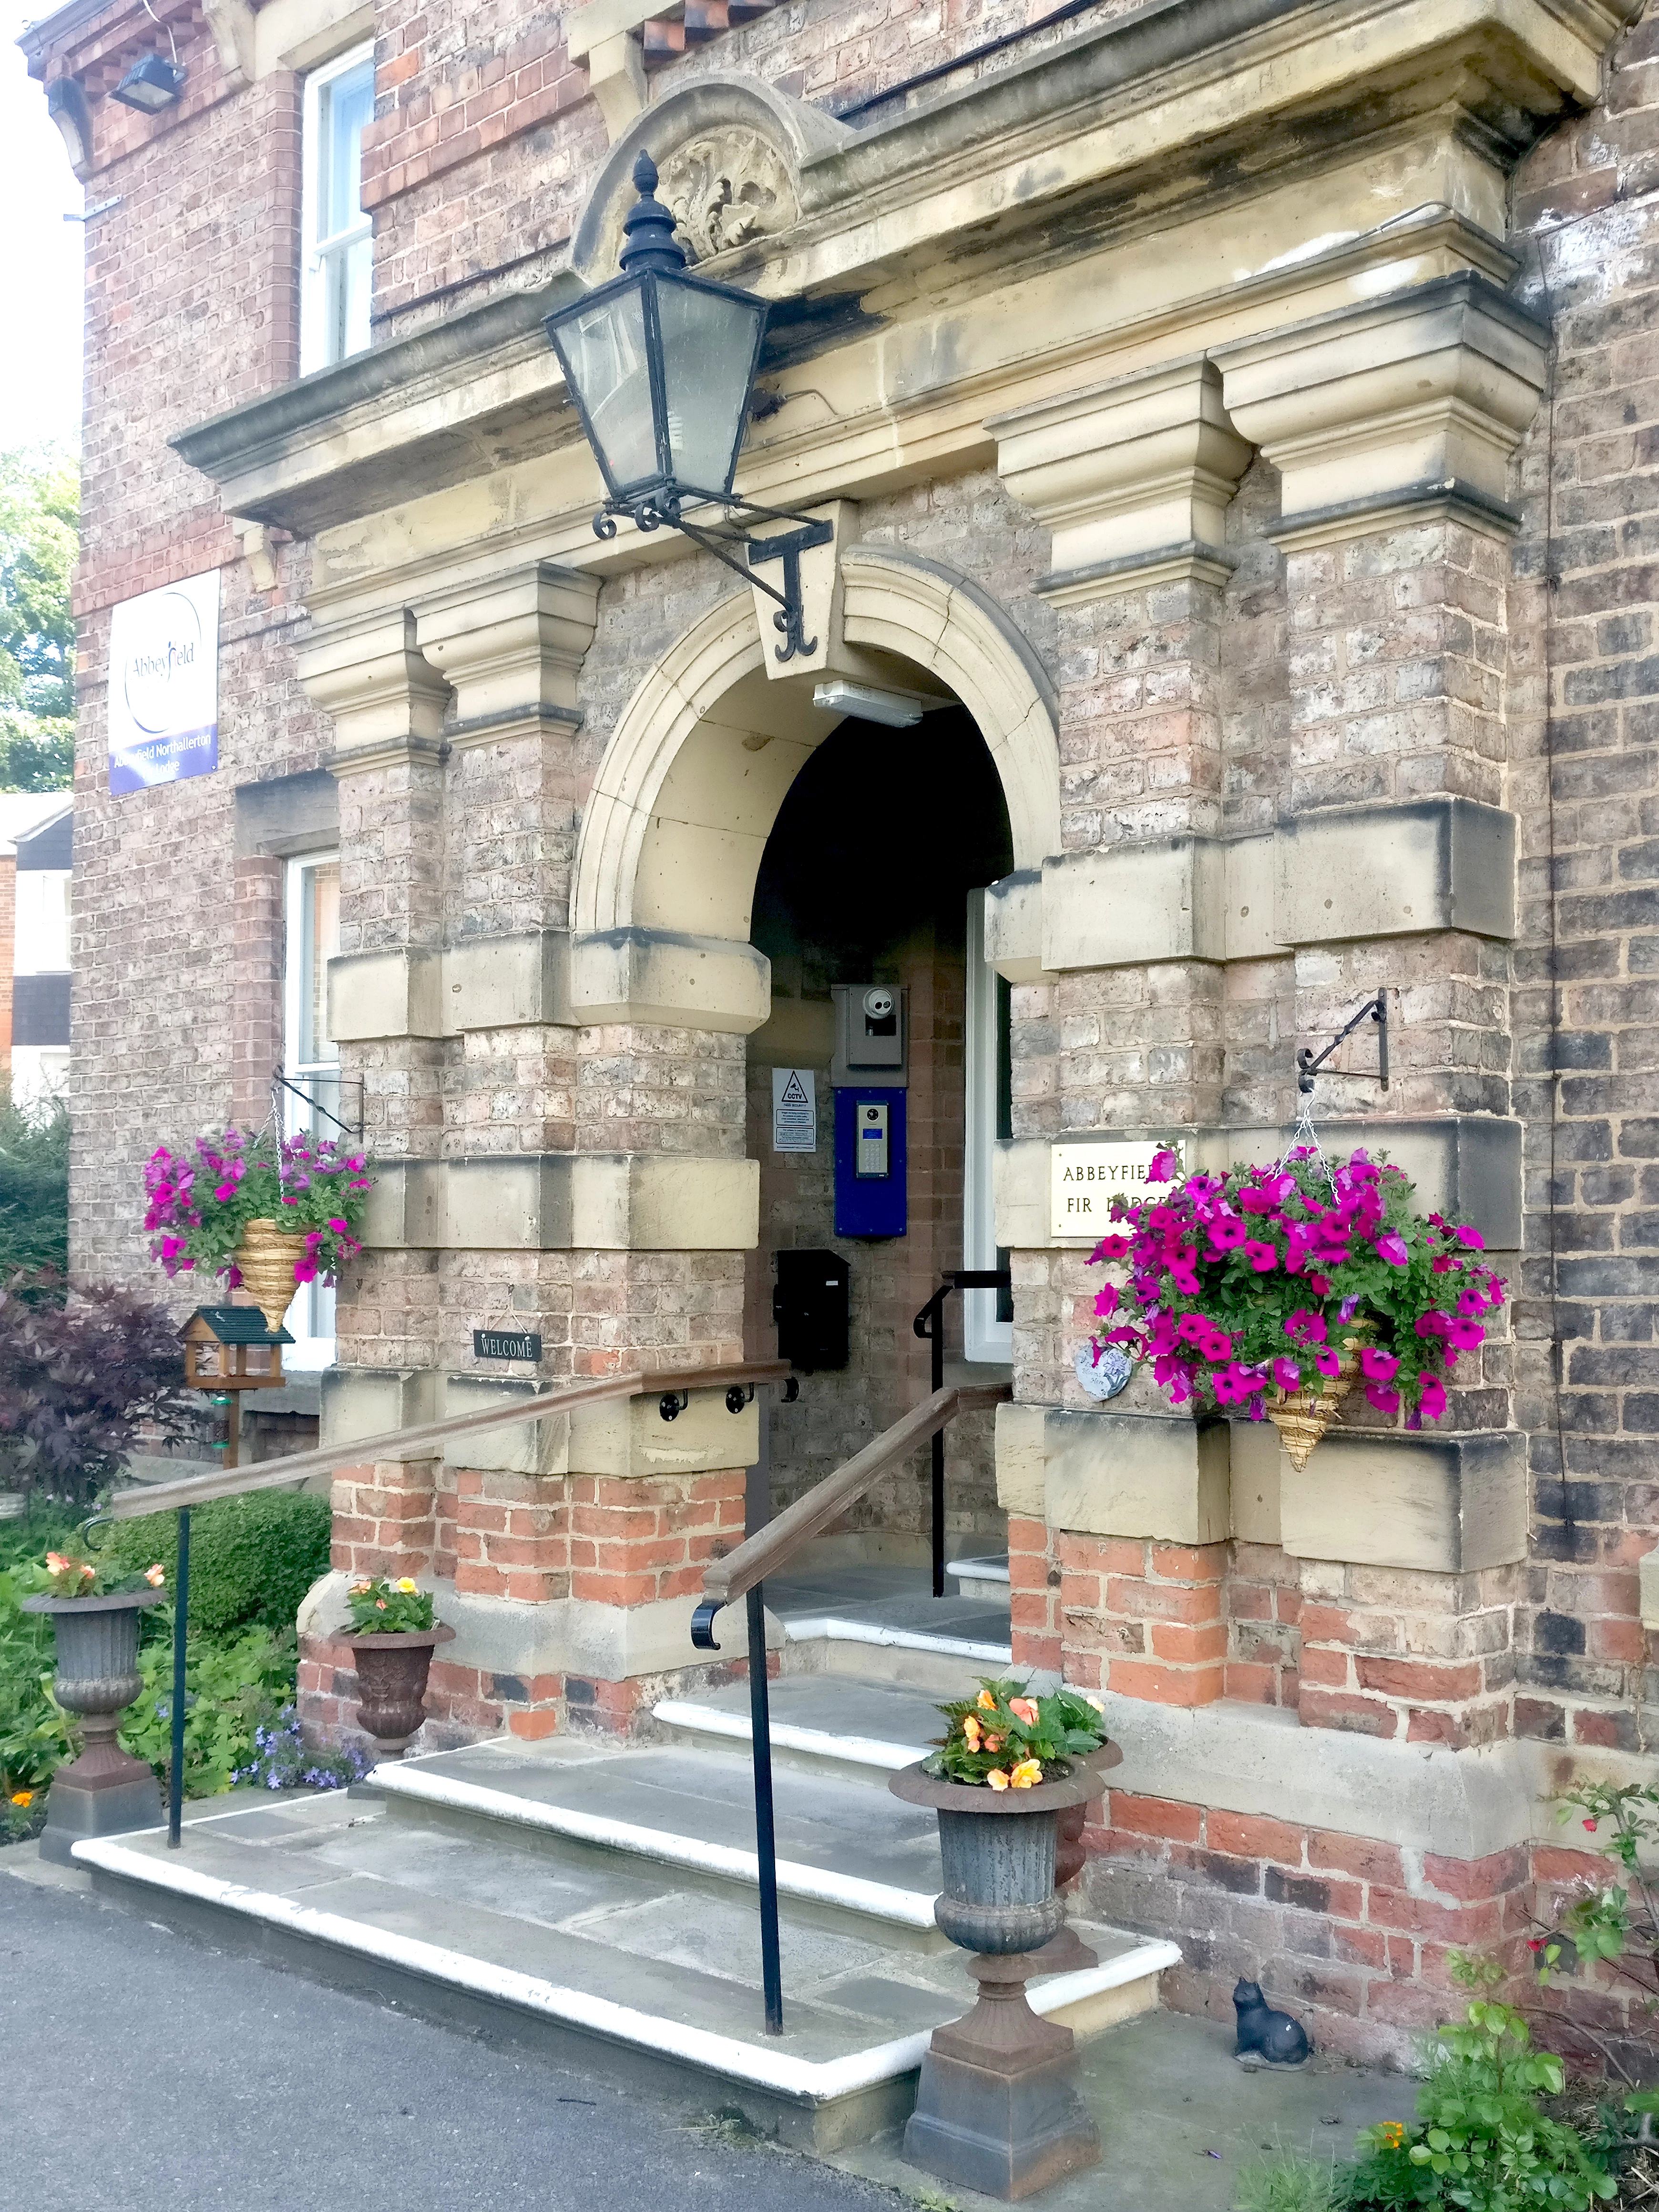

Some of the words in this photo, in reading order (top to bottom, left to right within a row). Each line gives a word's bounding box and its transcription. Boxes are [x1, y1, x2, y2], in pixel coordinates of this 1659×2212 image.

[133, 641, 194, 683] Abbeyfield
[155, 734, 211, 758] Northallerton
[156, 760, 180, 776] Lodge
[1067, 1198, 1092, 1212] FIR
[481, 1338, 533, 1357] WELCOME
